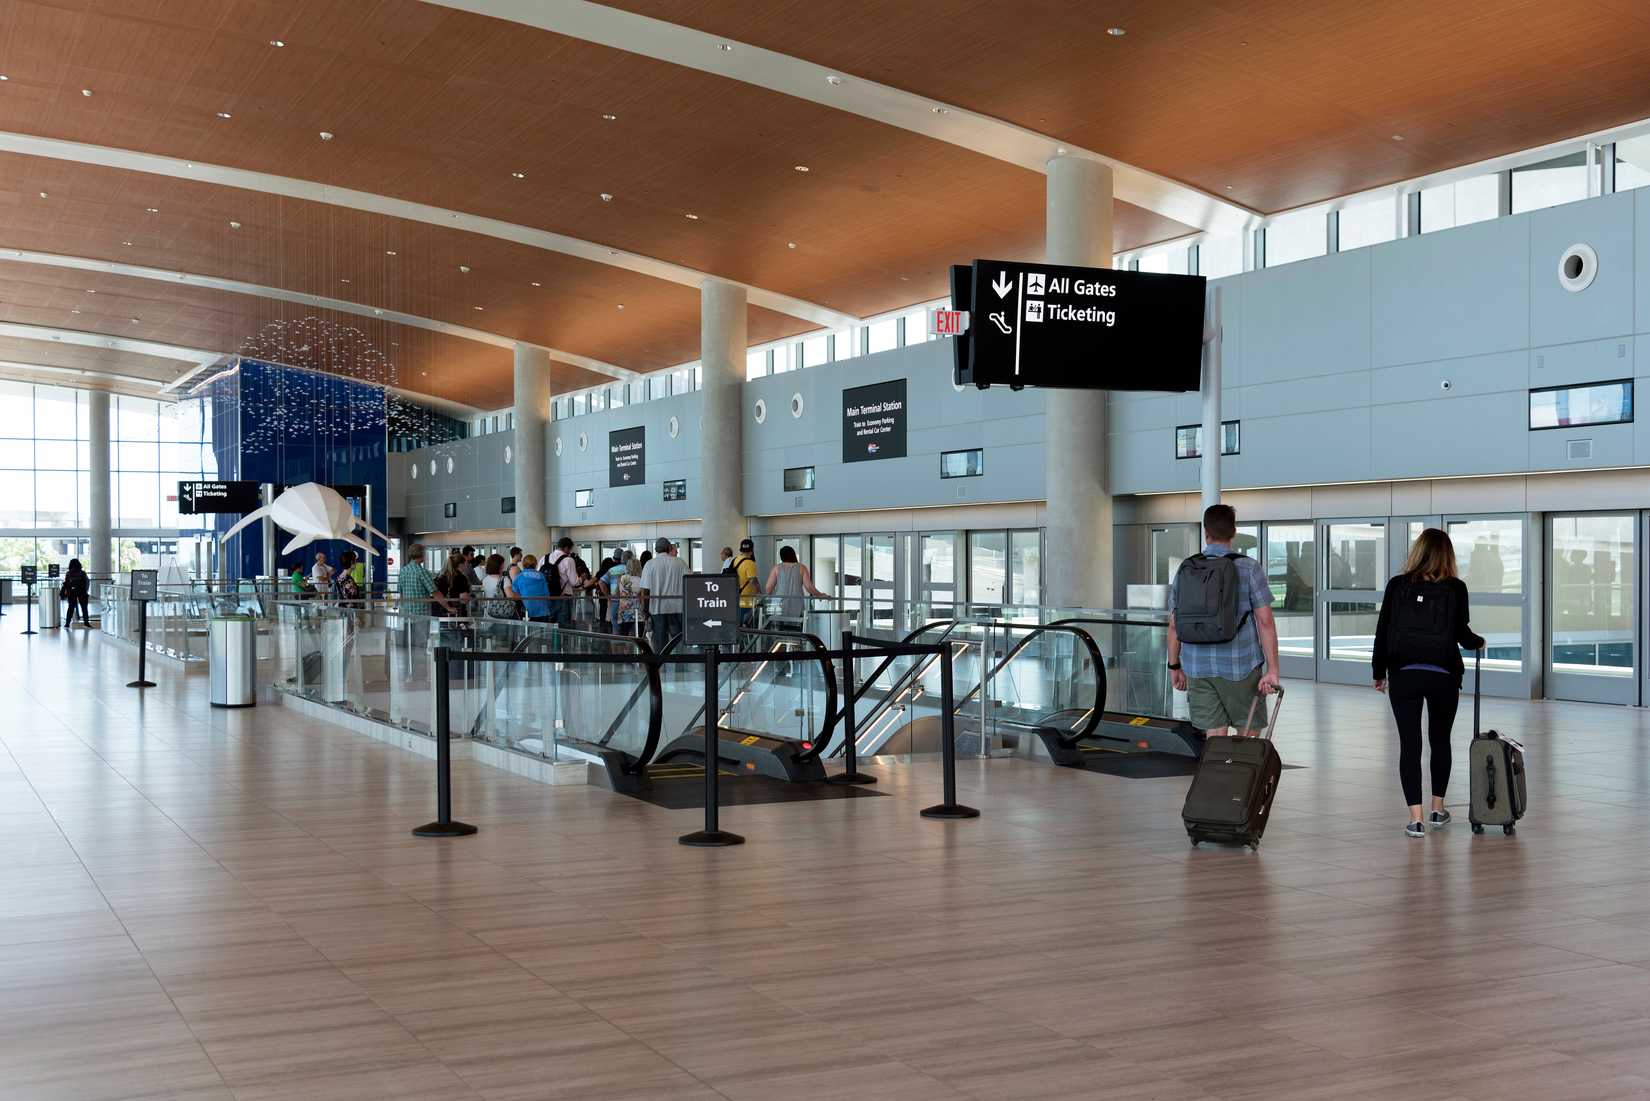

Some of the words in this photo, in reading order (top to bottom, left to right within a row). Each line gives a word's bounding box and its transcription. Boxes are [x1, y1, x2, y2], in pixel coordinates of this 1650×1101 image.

[1048, 278, 1069, 294] All
[1074, 279, 1116, 297] Gates
[935, 311, 961, 334] EXIT
[1047, 304, 1116, 327] Ticketing
[846, 406, 860, 417] Main
[860, 402, 882, 415] Terminal
[882, 400, 902, 412] Station
[881, 417, 895, 425] Parking
[704, 581, 720, 592] To
[696, 596, 728, 608] Train
